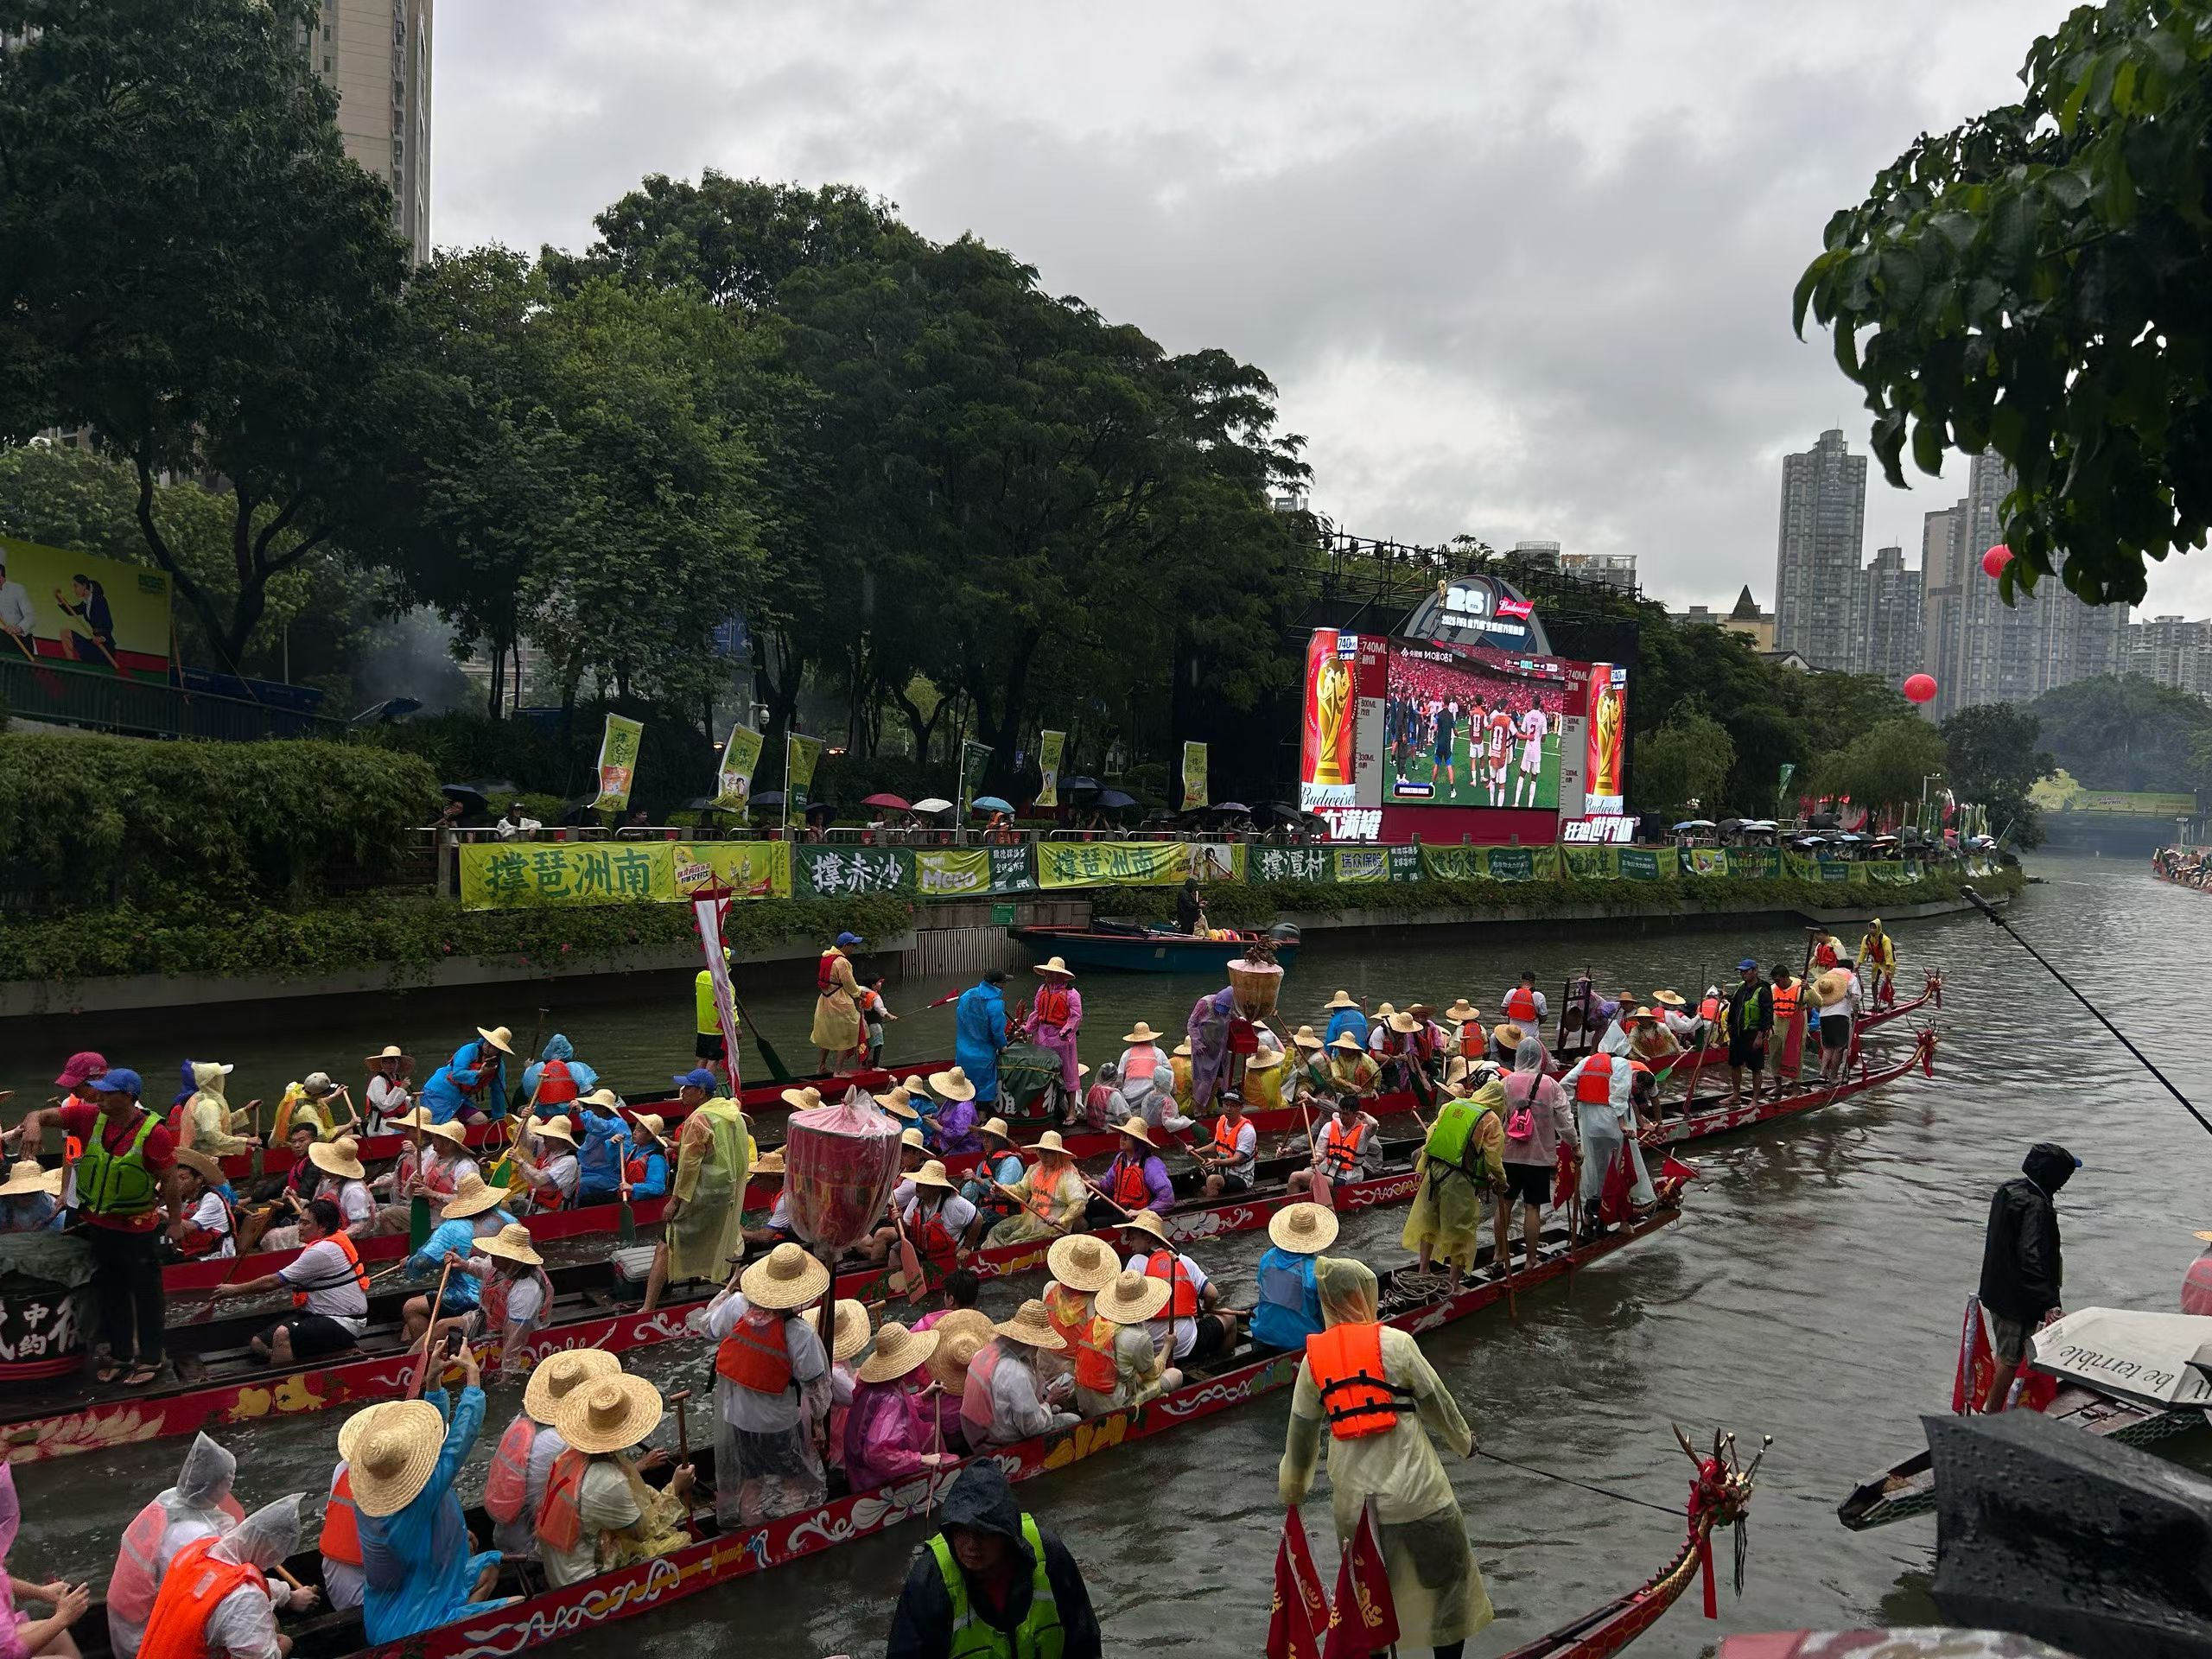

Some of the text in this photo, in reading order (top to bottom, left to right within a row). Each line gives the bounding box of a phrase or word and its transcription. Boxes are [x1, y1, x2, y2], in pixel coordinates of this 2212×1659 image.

[1499, 600, 1531, 614] Budweiser
[1363, 641, 1387, 654] 740ML
[1568, 670, 1588, 681] 740ML
[1360, 699, 1376, 709] 500ML
[1357, 753, 1376, 762] 330ML
[1301, 785, 1356, 807] Budweiser
[1052, 845, 1154, 883] 撑琶洲南
[1261, 849, 1326, 882] 撑潭村
[1341, 853, 1383, 868] 瑞众保险
[484, 847, 652, 899] 撑琶洲南
[811, 852, 903, 894] 撑赤沙
[2060, 1345, 2143, 1380] terrible
[2144, 1370, 2175, 1393] be
